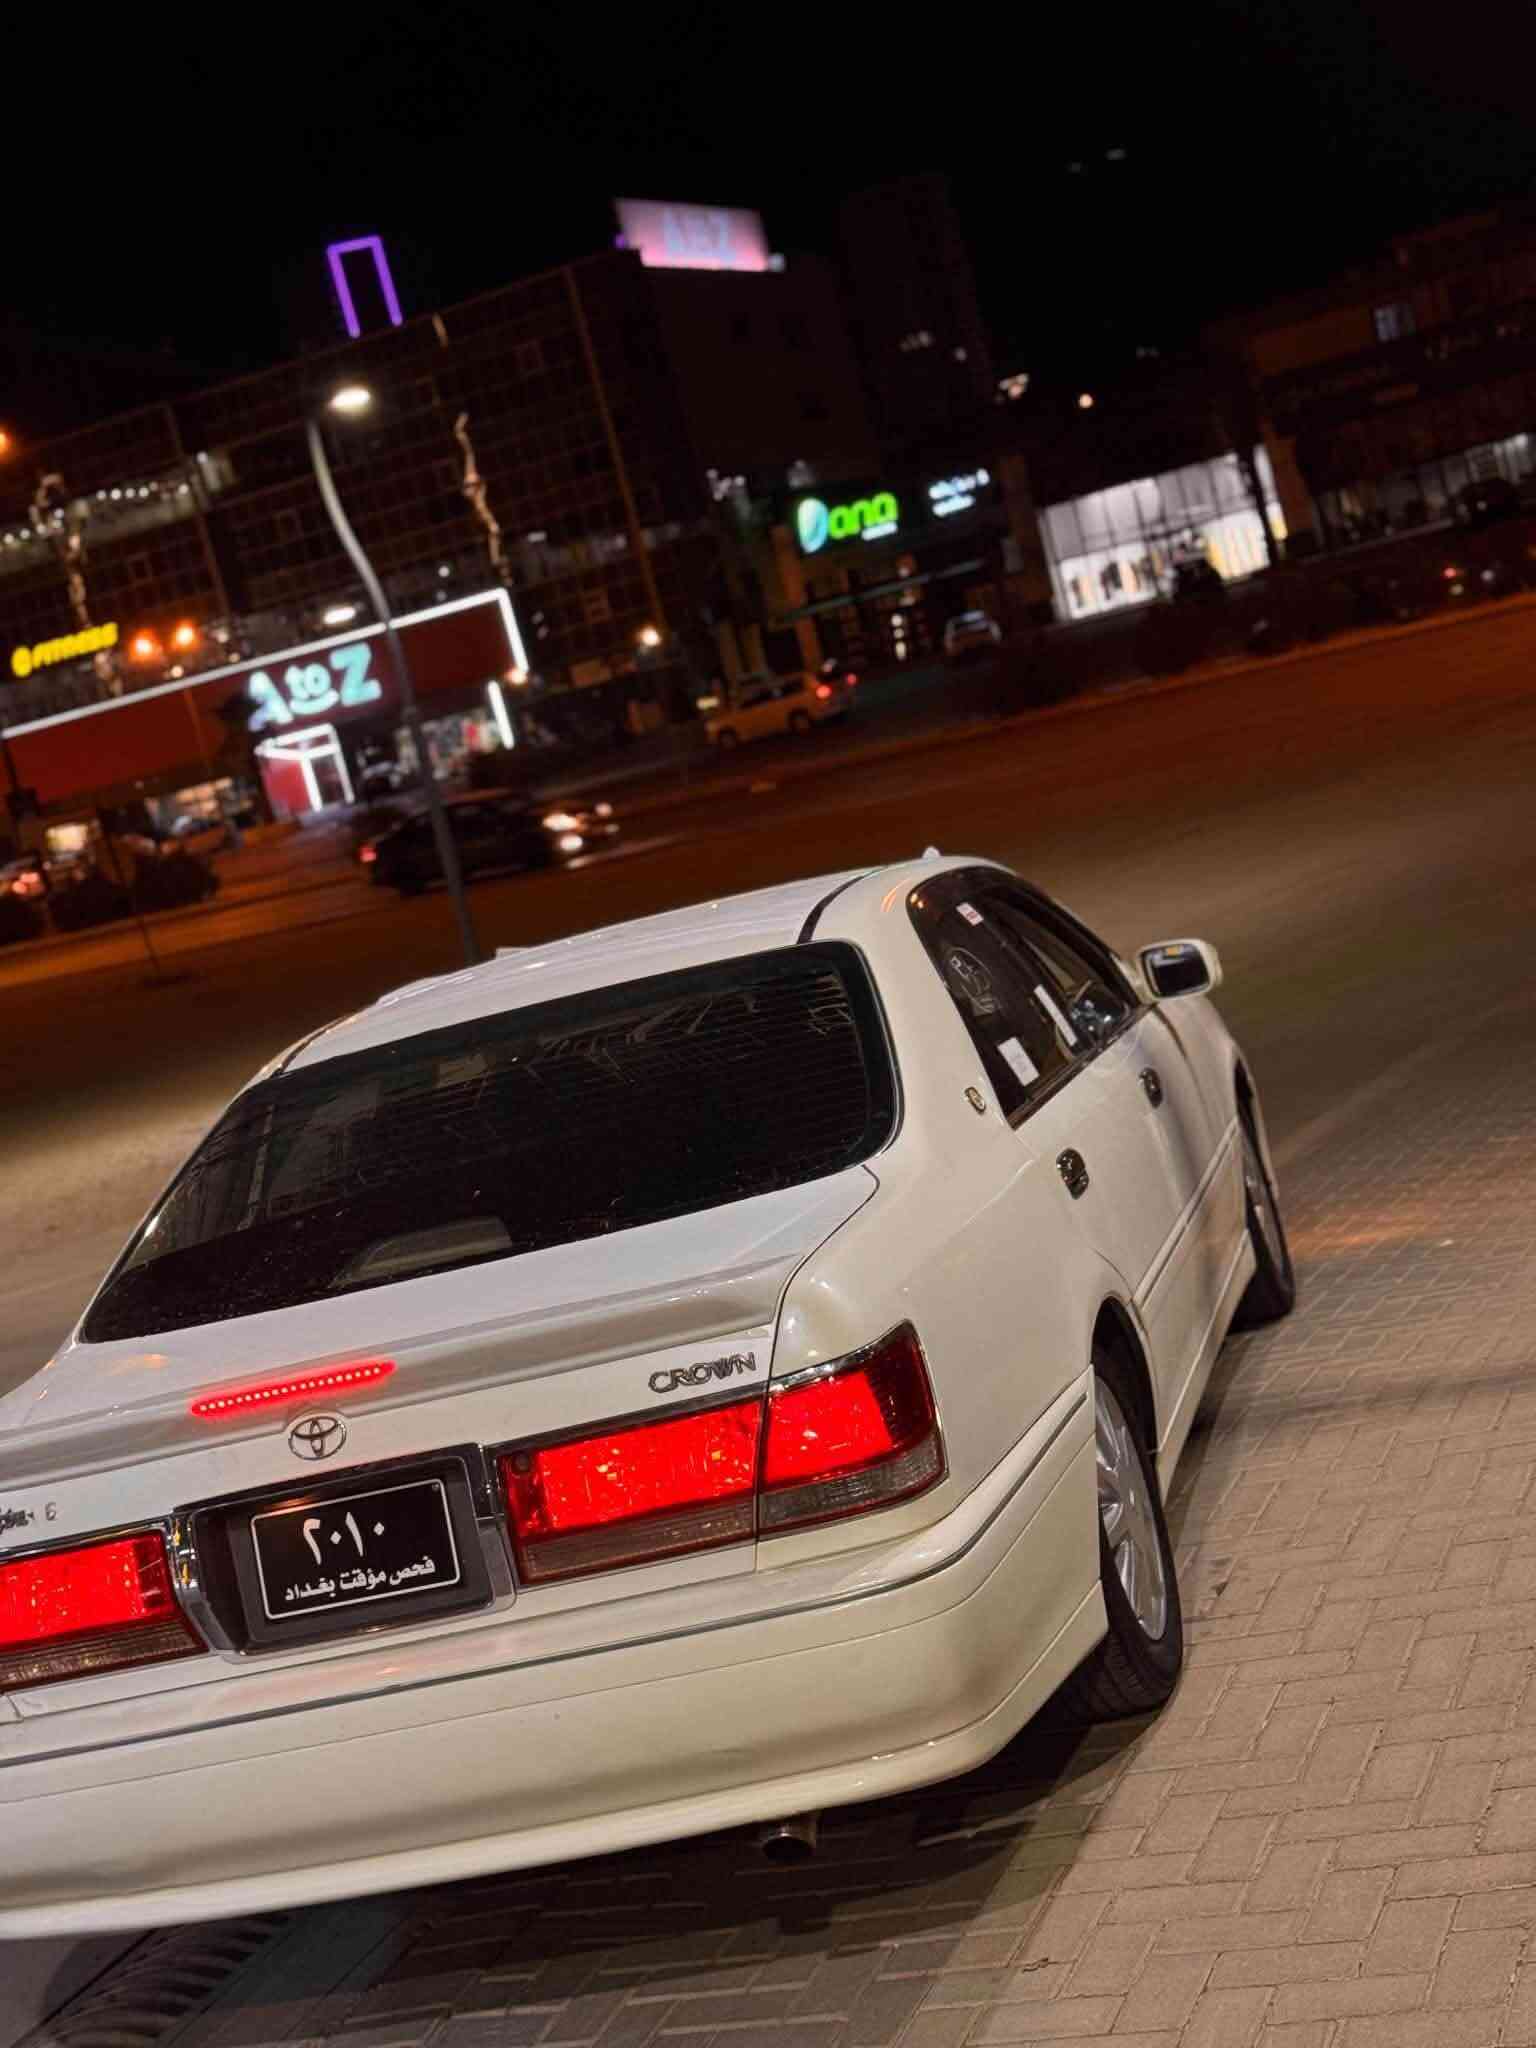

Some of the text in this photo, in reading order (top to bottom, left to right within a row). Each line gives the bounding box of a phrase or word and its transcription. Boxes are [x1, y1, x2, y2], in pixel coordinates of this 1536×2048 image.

[648, 1352, 757, 1393] CROWN
[302, 1511, 385, 1566] ٢٠١٠
[284, 1555, 436, 1601] فحص مؤقت بغداد
